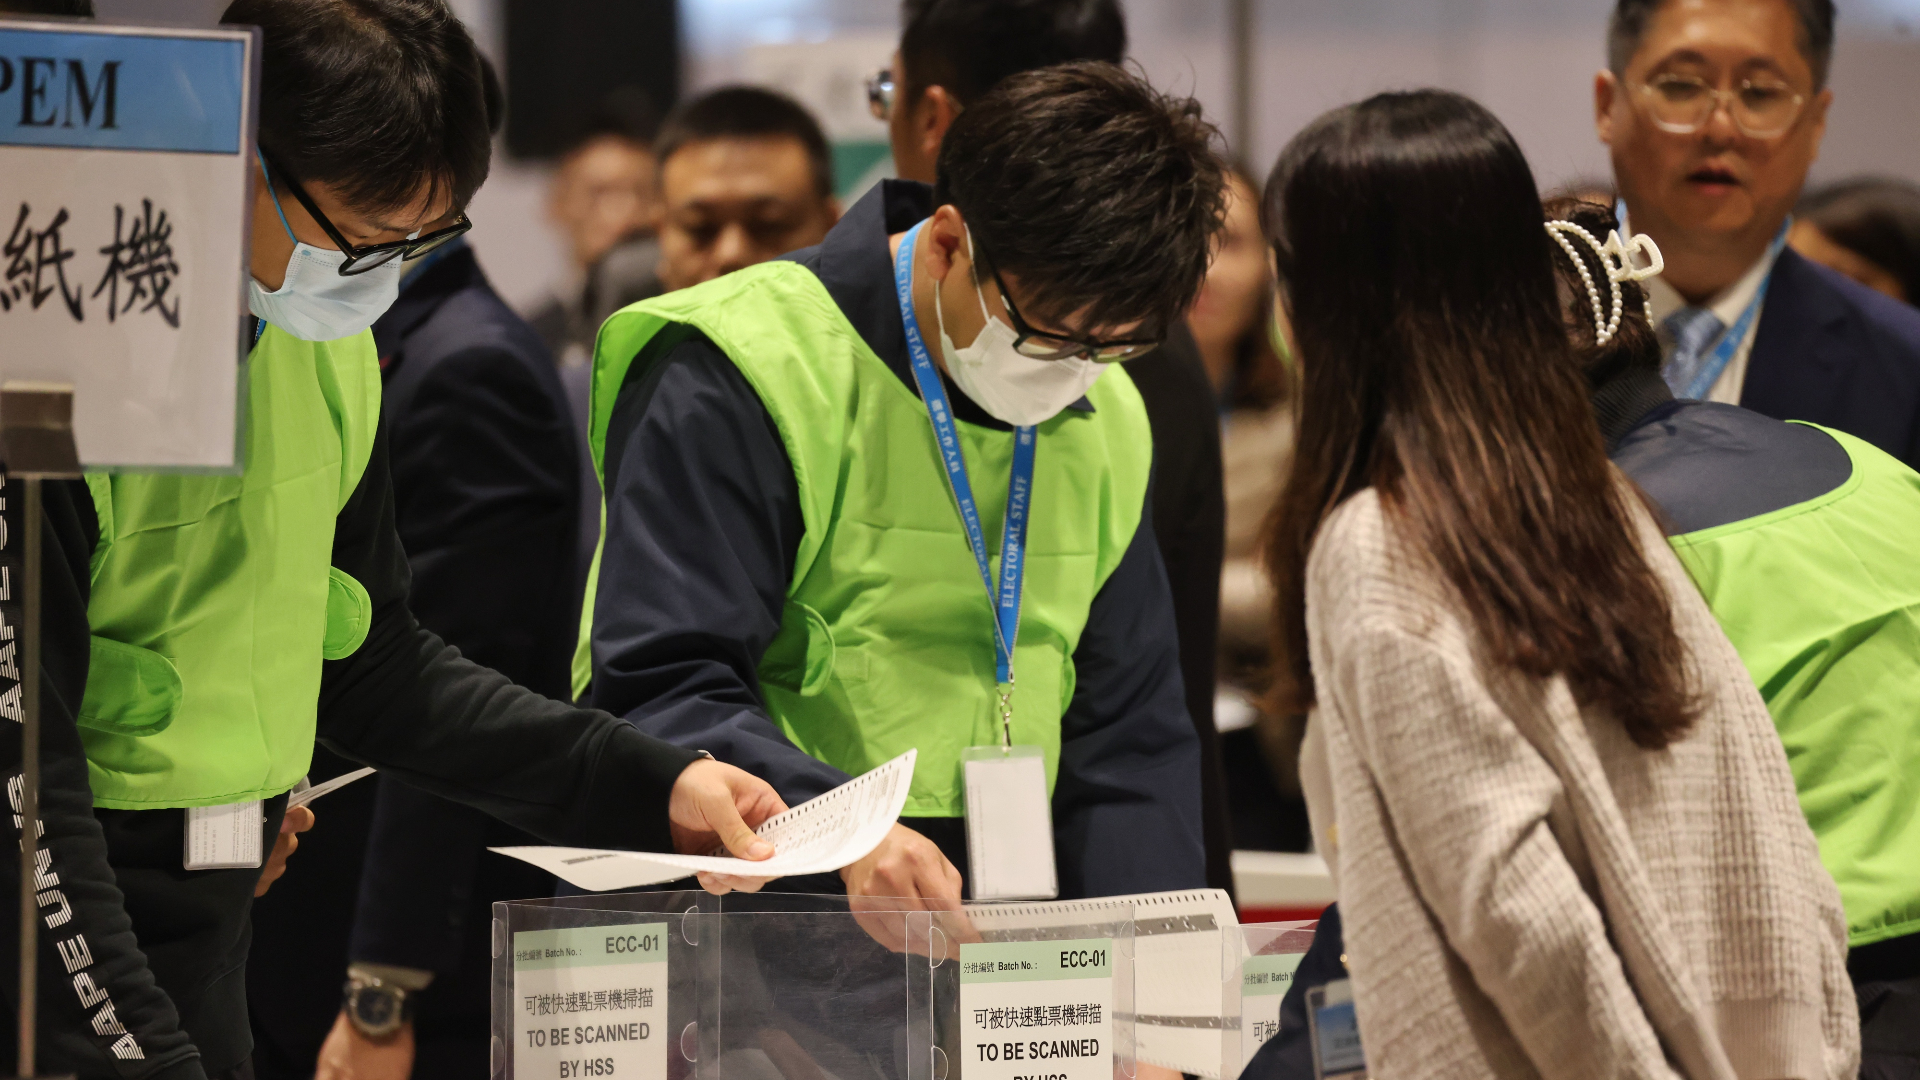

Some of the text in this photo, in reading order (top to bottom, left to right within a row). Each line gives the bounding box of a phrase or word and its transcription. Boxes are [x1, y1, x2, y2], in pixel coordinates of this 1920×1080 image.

[0, 197, 180, 329] 紙機
[898, 244, 931, 369] ELECTORAL STAFF
[1002, 475, 1028, 608] ELECTORAL STAFF
[545, 948, 564, 958] Batch
[605, 934, 659, 954] ECC-01
[963, 962, 995, 974] 分批編號
[998, 961, 1020, 971] Batch
[1060, 949, 1106, 969] ECC-01
[1271, 972, 1289, 982] Batch
[57, 933, 146, 1060] AAPE
[524, 987, 654, 1016] 可被快速點票機掃描
[973, 1003, 1102, 1030] 可被快速點票機掃描
[527, 1022, 650, 1048] TO BE SCANNED
[977, 1038, 1100, 1062] TO BE SCANNED
[560, 1057, 615, 1079] BY HSS
